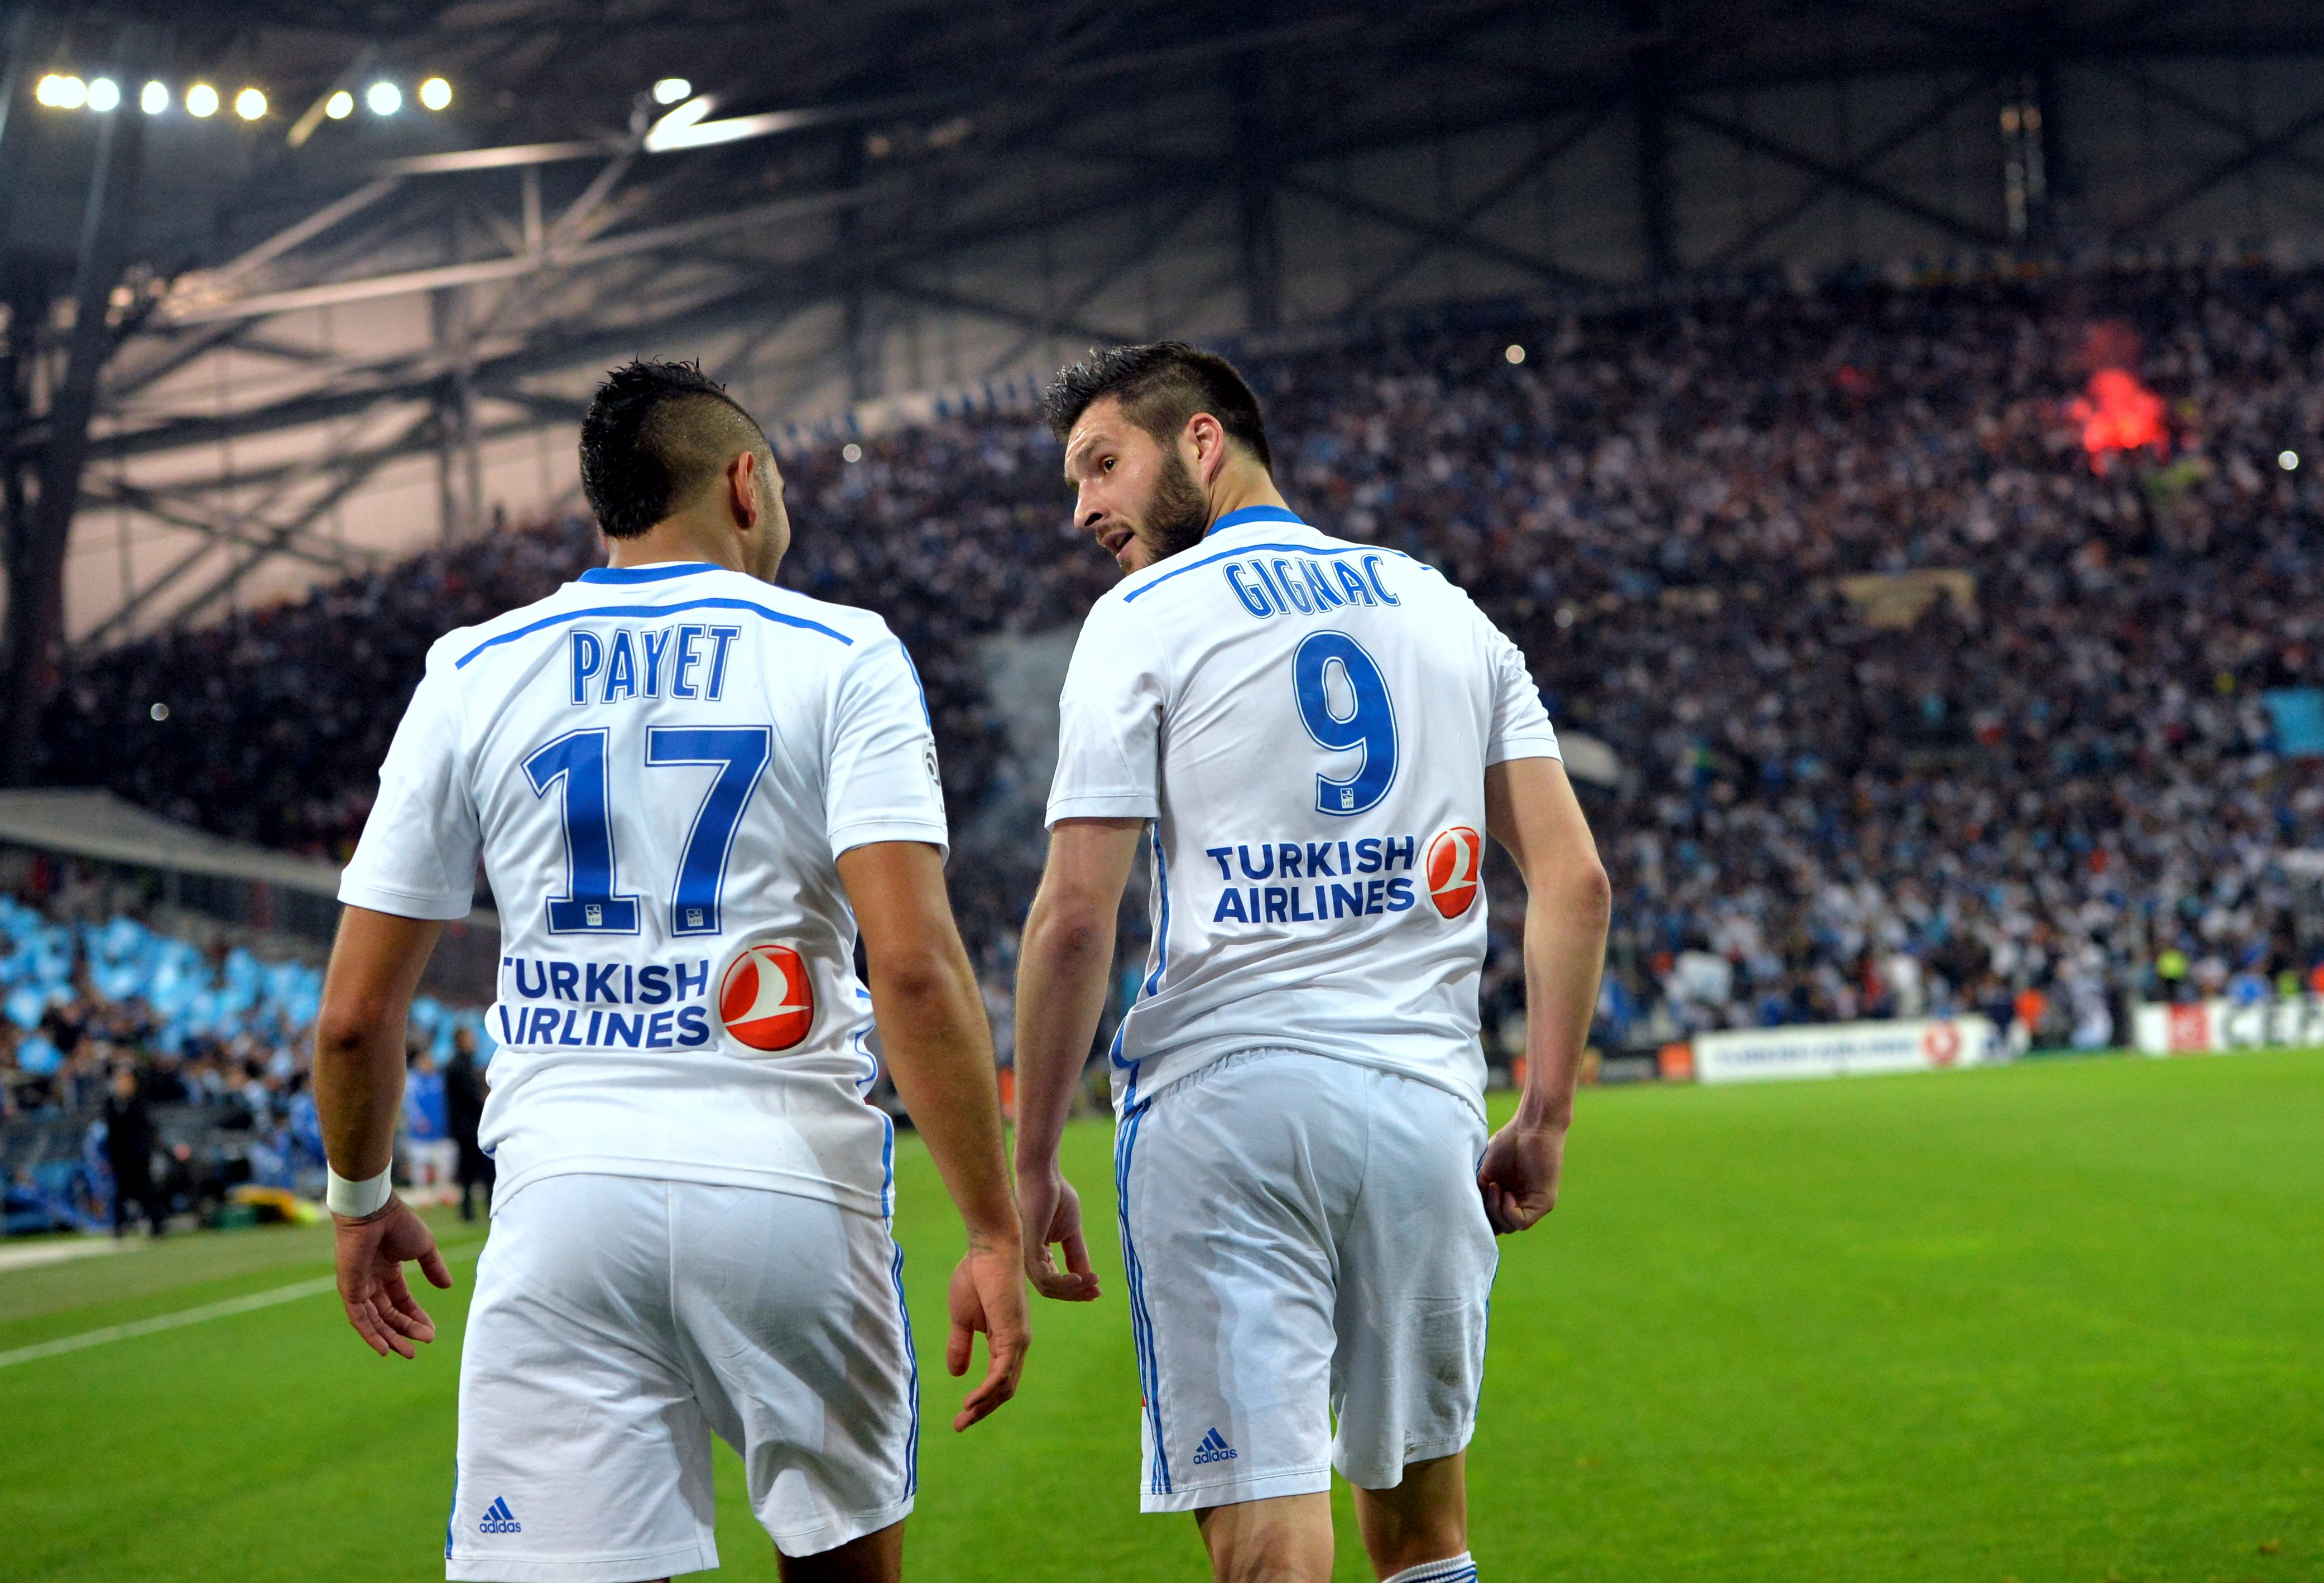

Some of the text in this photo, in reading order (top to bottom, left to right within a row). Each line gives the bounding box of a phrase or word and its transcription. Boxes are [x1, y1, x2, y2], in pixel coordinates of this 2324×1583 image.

[1223, 555, 1400, 618] GIGNAC
[569, 623, 741, 706] PAYET
[1291, 629, 1400, 817] 9
[520, 725, 774, 937] 17
[1206, 836, 1414, 880] TURKISH
[1213, 877, 1416, 923] AIRLINES
[1193, 1449, 1238, 1465] adidas
[479, 1519, 522, 1533] adidas
